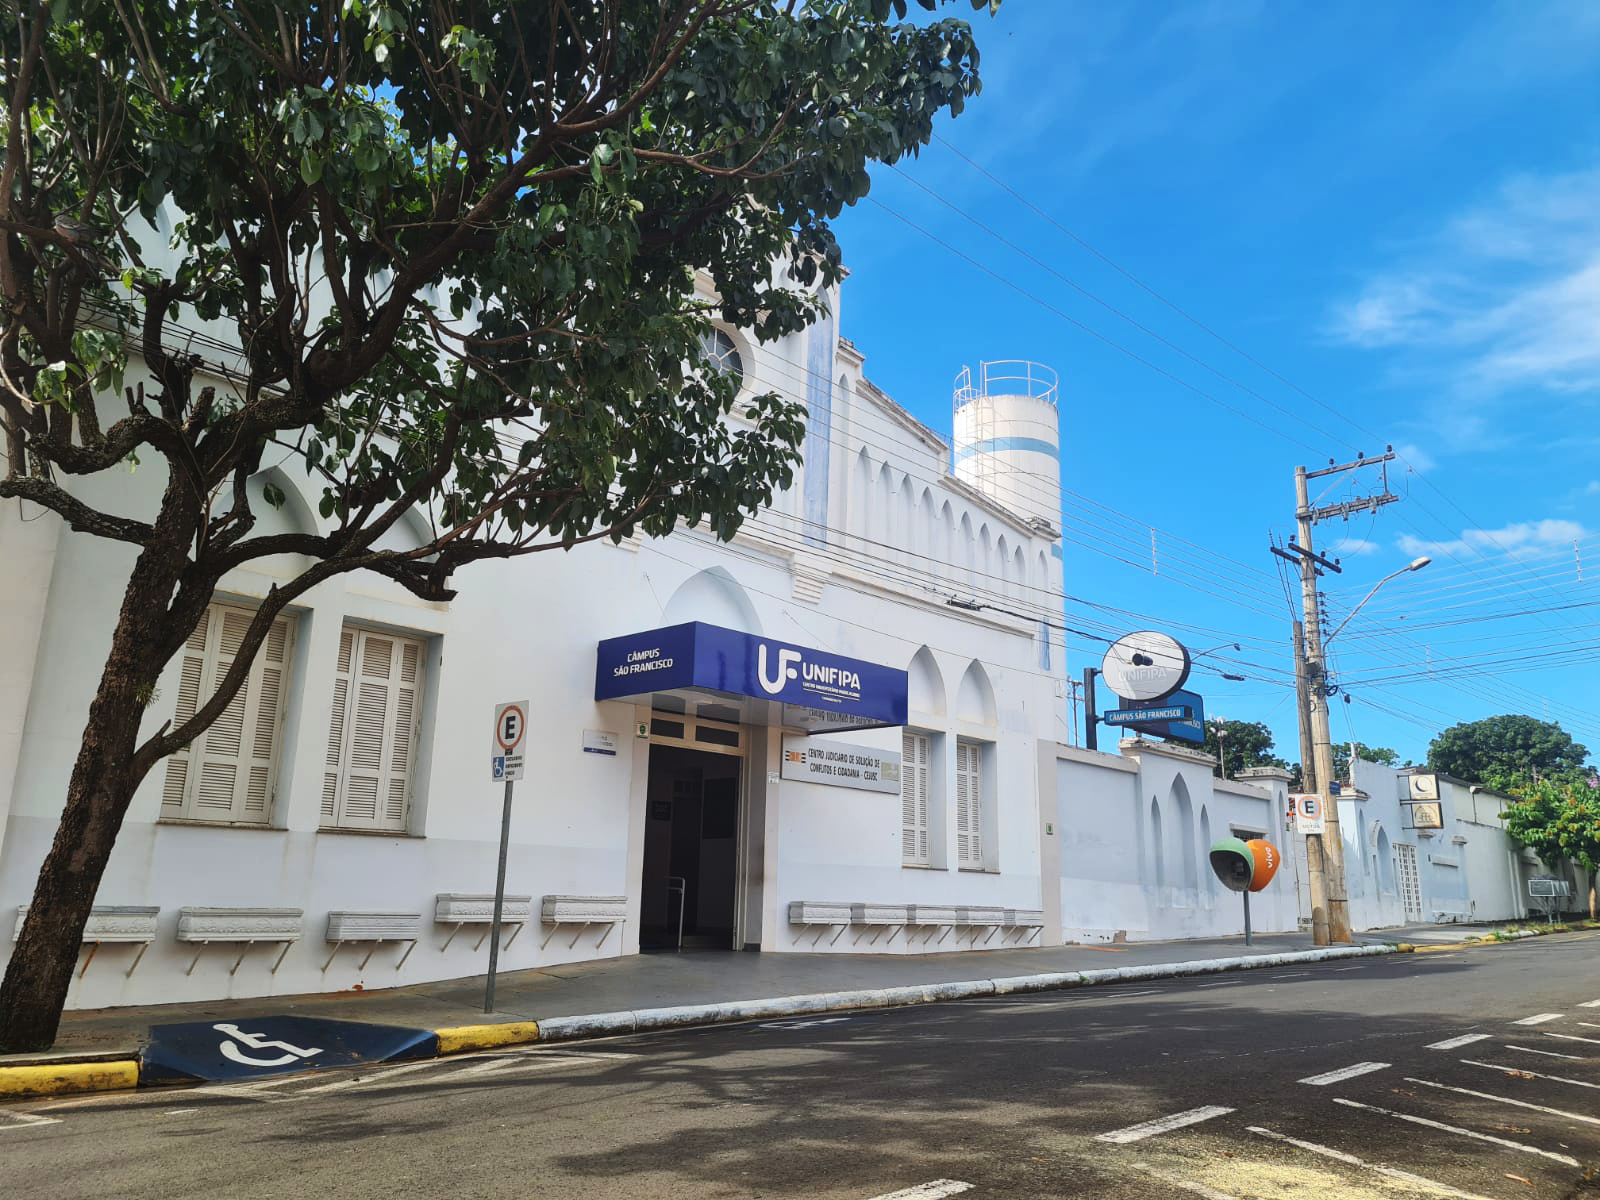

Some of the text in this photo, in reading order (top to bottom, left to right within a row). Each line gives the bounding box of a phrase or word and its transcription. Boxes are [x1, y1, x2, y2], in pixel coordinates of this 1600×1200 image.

[627, 648, 660, 663] CÂMPUS
[613, 658, 673, 677] SÃO FRANCISCO
[1118, 667, 1168, 681] UNIFIPA
[802, 662, 861, 690] UNIFIPA
[1135, 710, 1147, 720] SÃO
[1147, 708, 1181, 719] FRANCISCO
[505, 715, 516, 740] E
[808, 748, 825, 760] CENTRO
[849, 754, 855, 764] DE
[874, 759, 880, 768] DE
[810, 763, 832, 775] CONFLITOS
[838, 767, 860, 778] CIDADANIA
[1305, 800, 1314, 814] E
